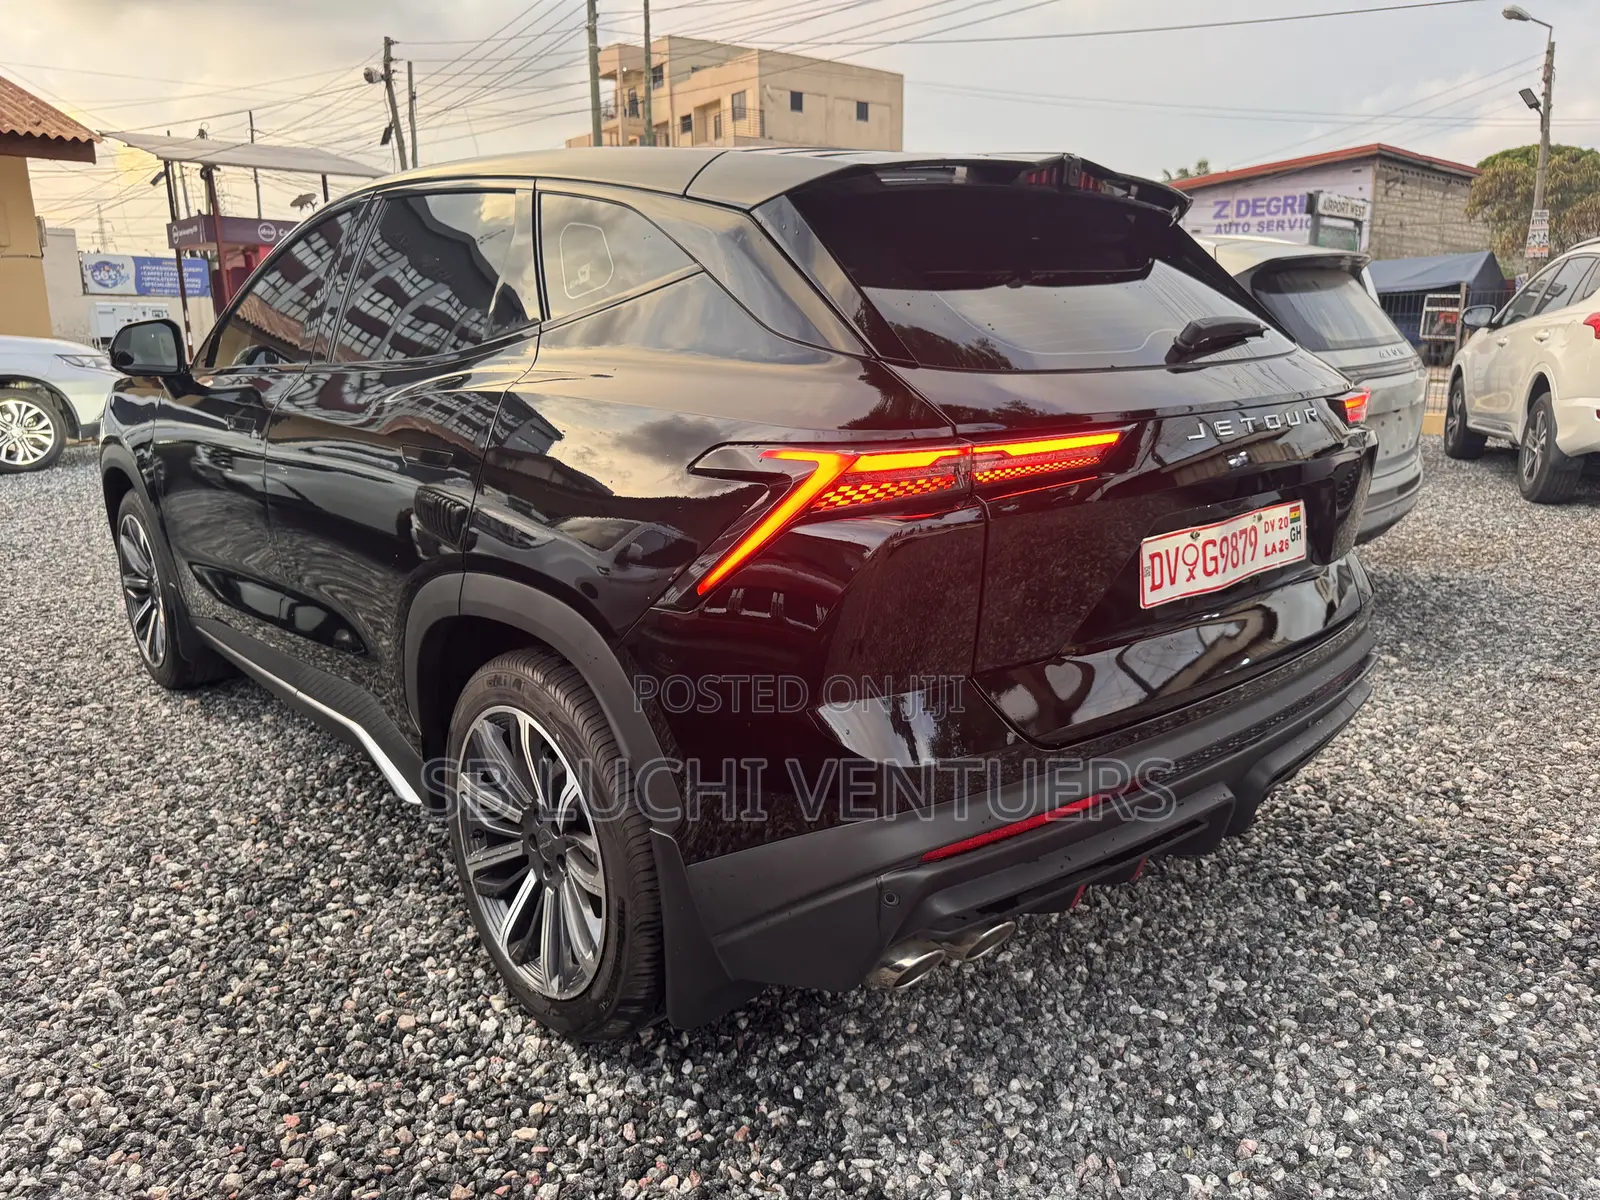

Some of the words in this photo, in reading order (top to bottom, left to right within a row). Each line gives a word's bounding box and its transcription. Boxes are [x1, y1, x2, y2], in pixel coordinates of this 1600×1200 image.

[1213, 201, 1230, 219] Z
[1321, 197, 1350, 216] AIRPORT
[1350, 202, 1367, 218] WEST
[1215, 222, 1250, 235] AUTO
[1186, 407, 1318, 441] JETOUR
[1263, 520, 1276, 534] DV
[1278, 516, 1289, 530] 20
[1289, 525, 1302, 543] GH
[1264, 542, 1277, 558] LA
